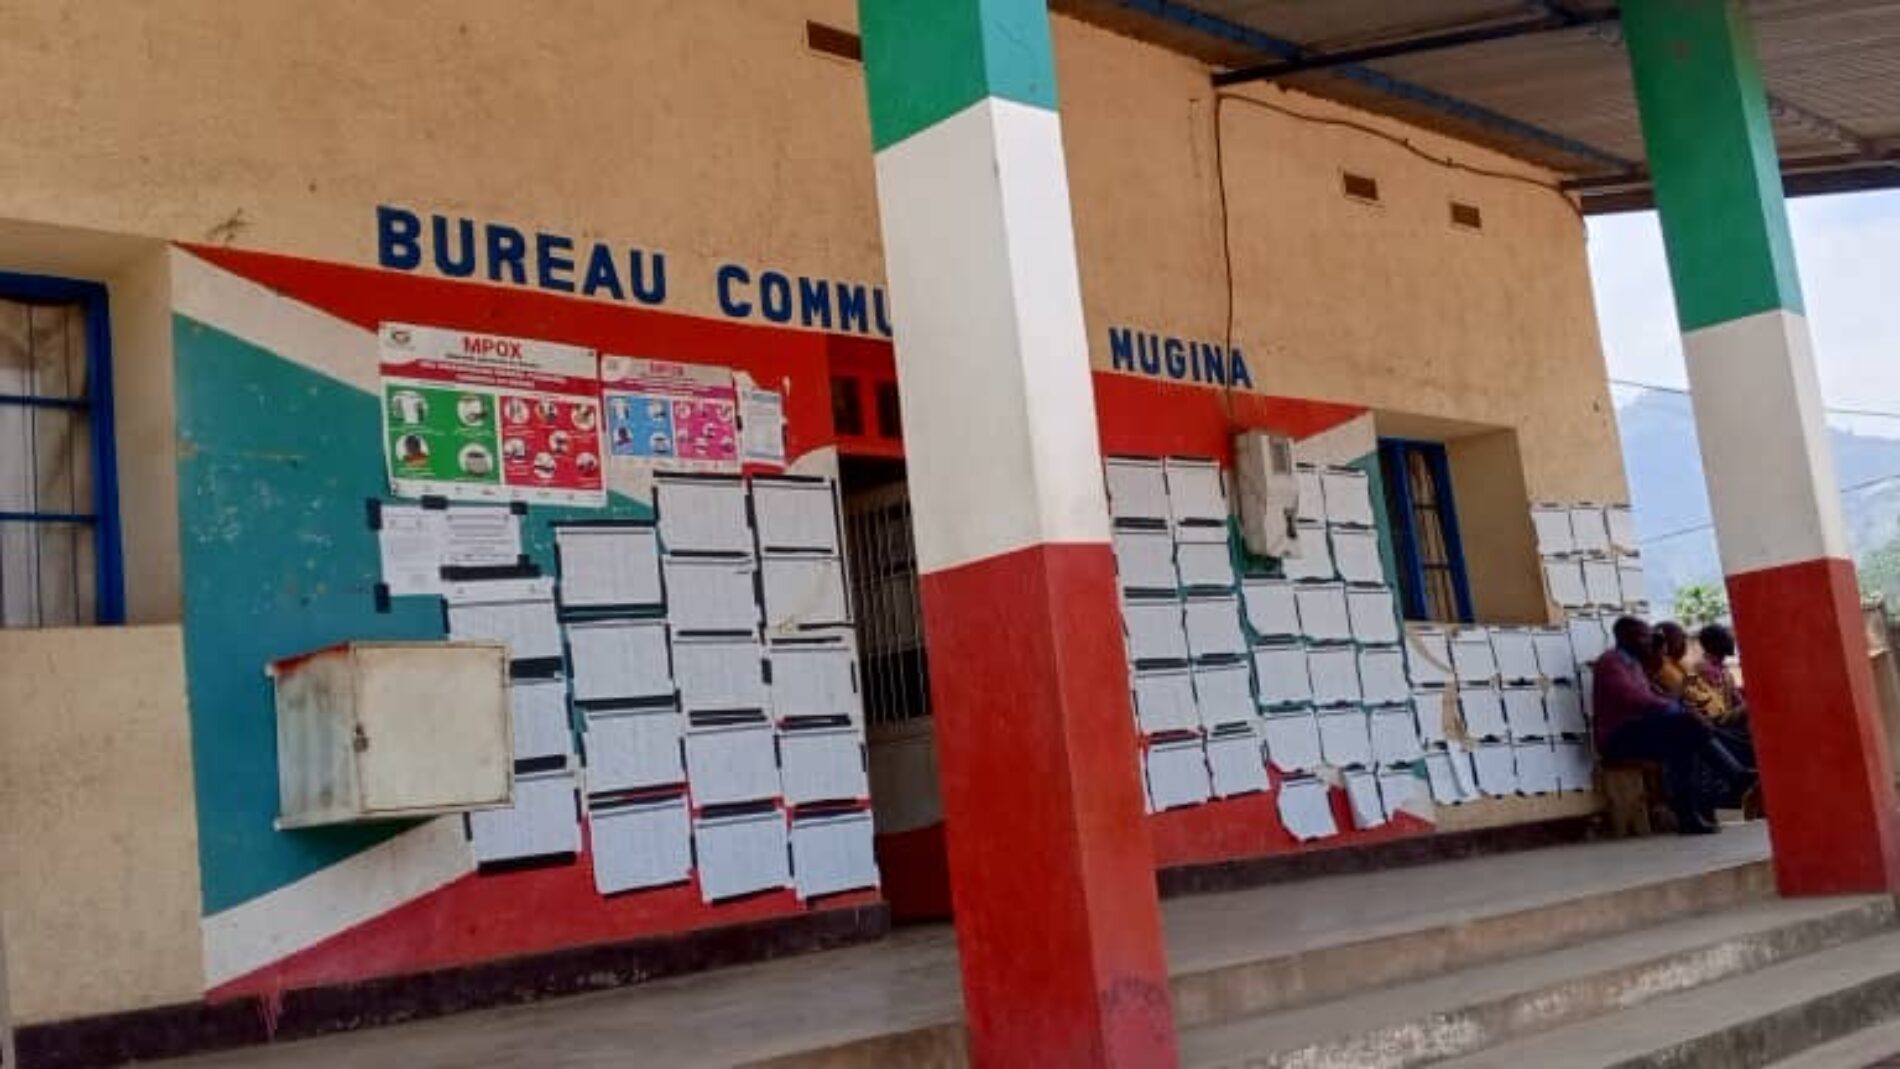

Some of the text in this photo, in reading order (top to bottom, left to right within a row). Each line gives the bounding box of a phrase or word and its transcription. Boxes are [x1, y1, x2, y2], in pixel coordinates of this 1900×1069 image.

[376, 205, 667, 304] BUREAU
[1108, 327, 1252, 389] MUGINA
[463, 336, 523, 359] MPOX
